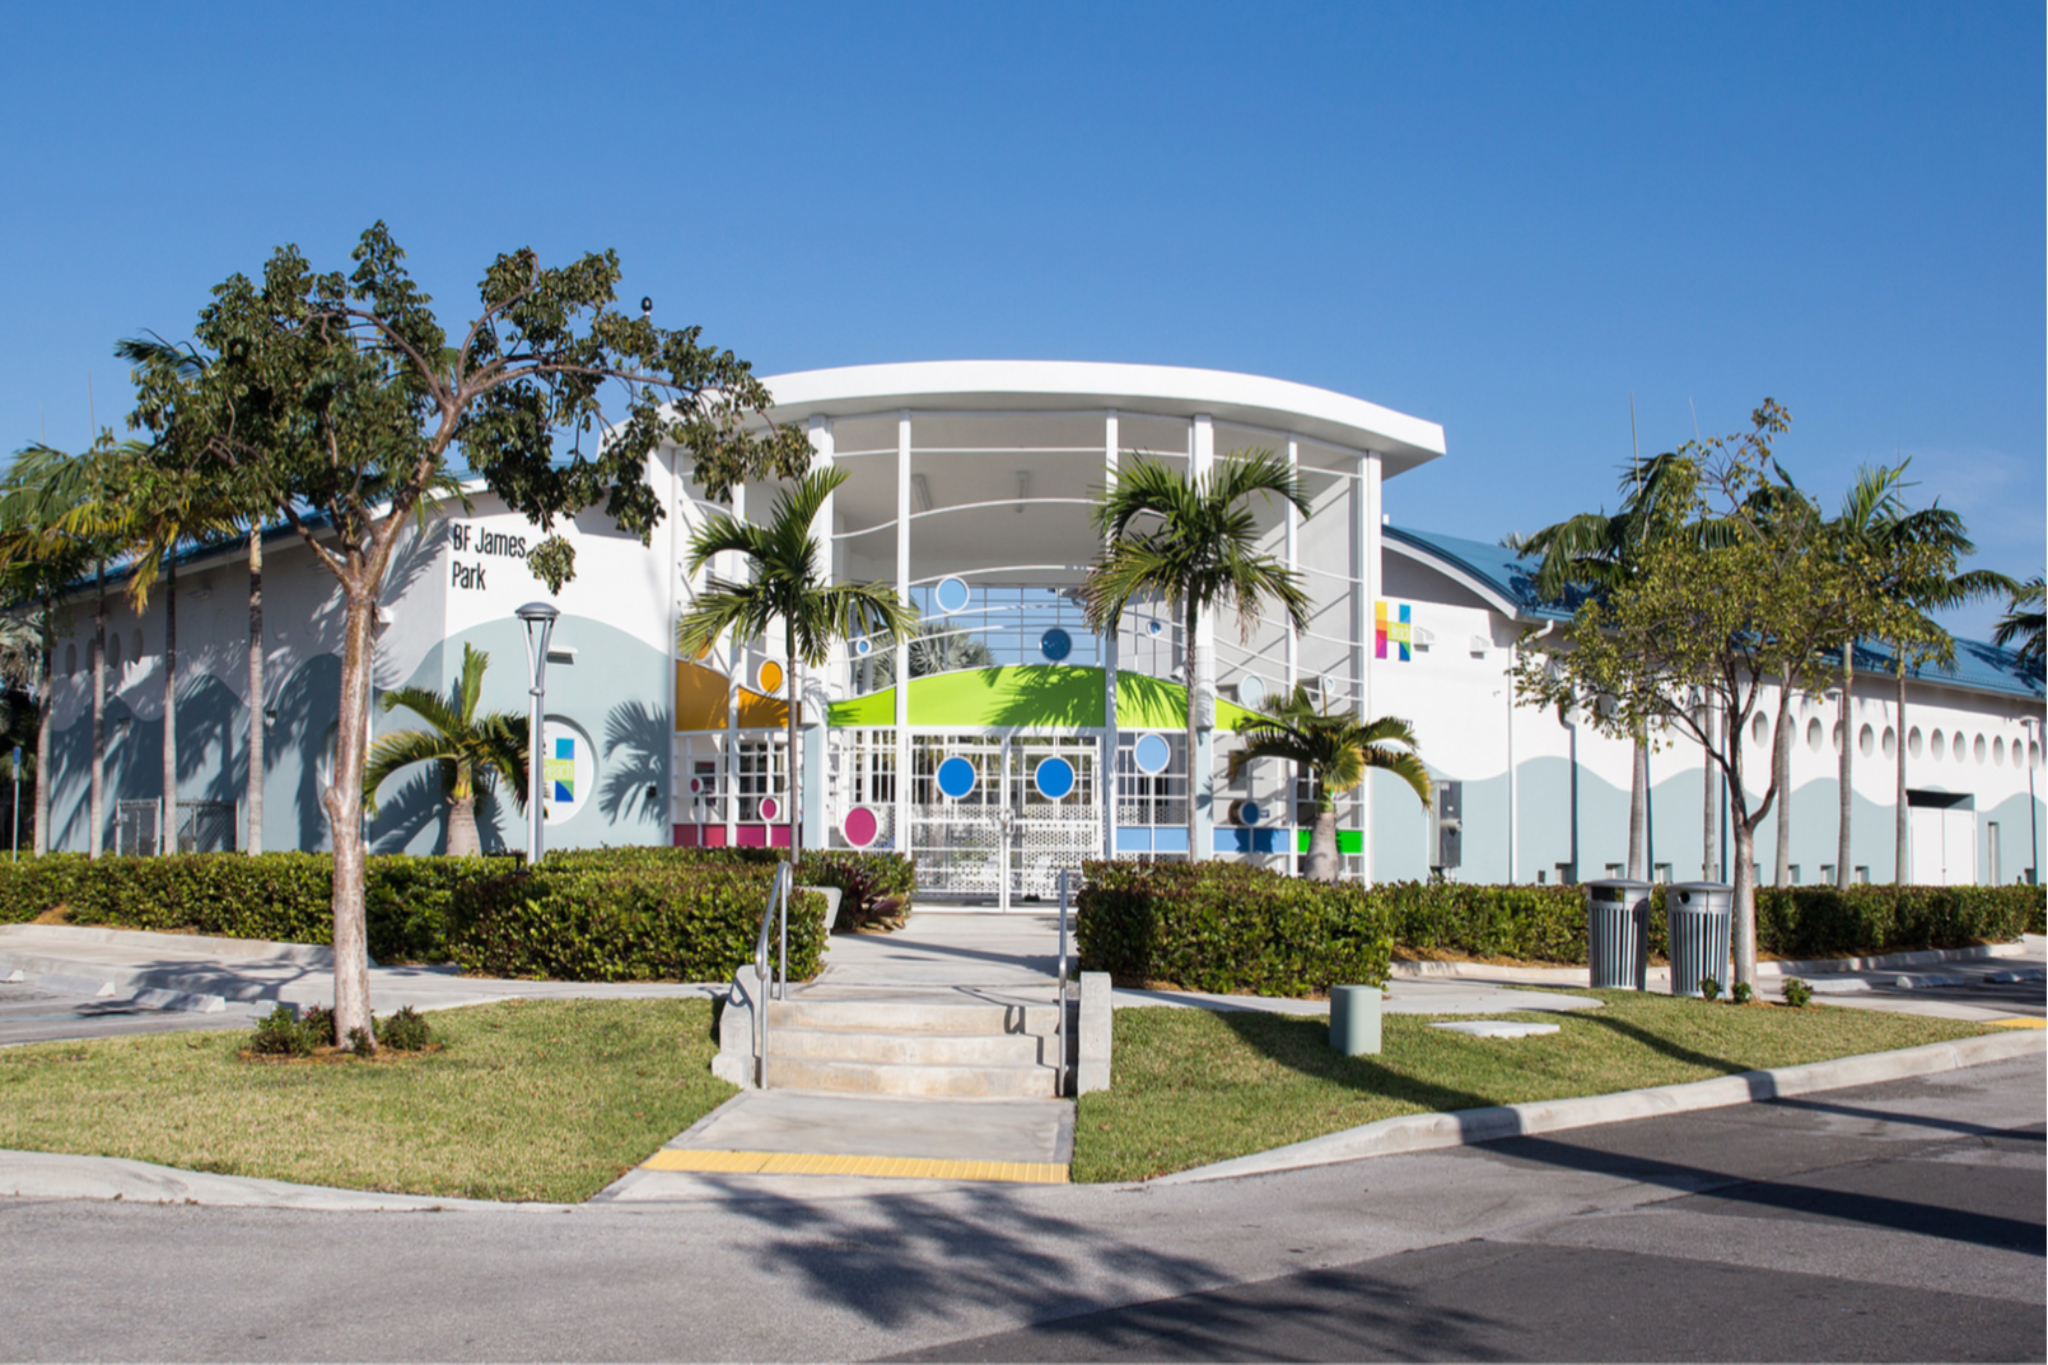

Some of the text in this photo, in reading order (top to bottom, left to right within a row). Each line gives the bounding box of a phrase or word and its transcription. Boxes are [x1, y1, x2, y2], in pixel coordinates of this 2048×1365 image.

[453, 524, 527, 559] BF James
[452, 560, 486, 591] Park
